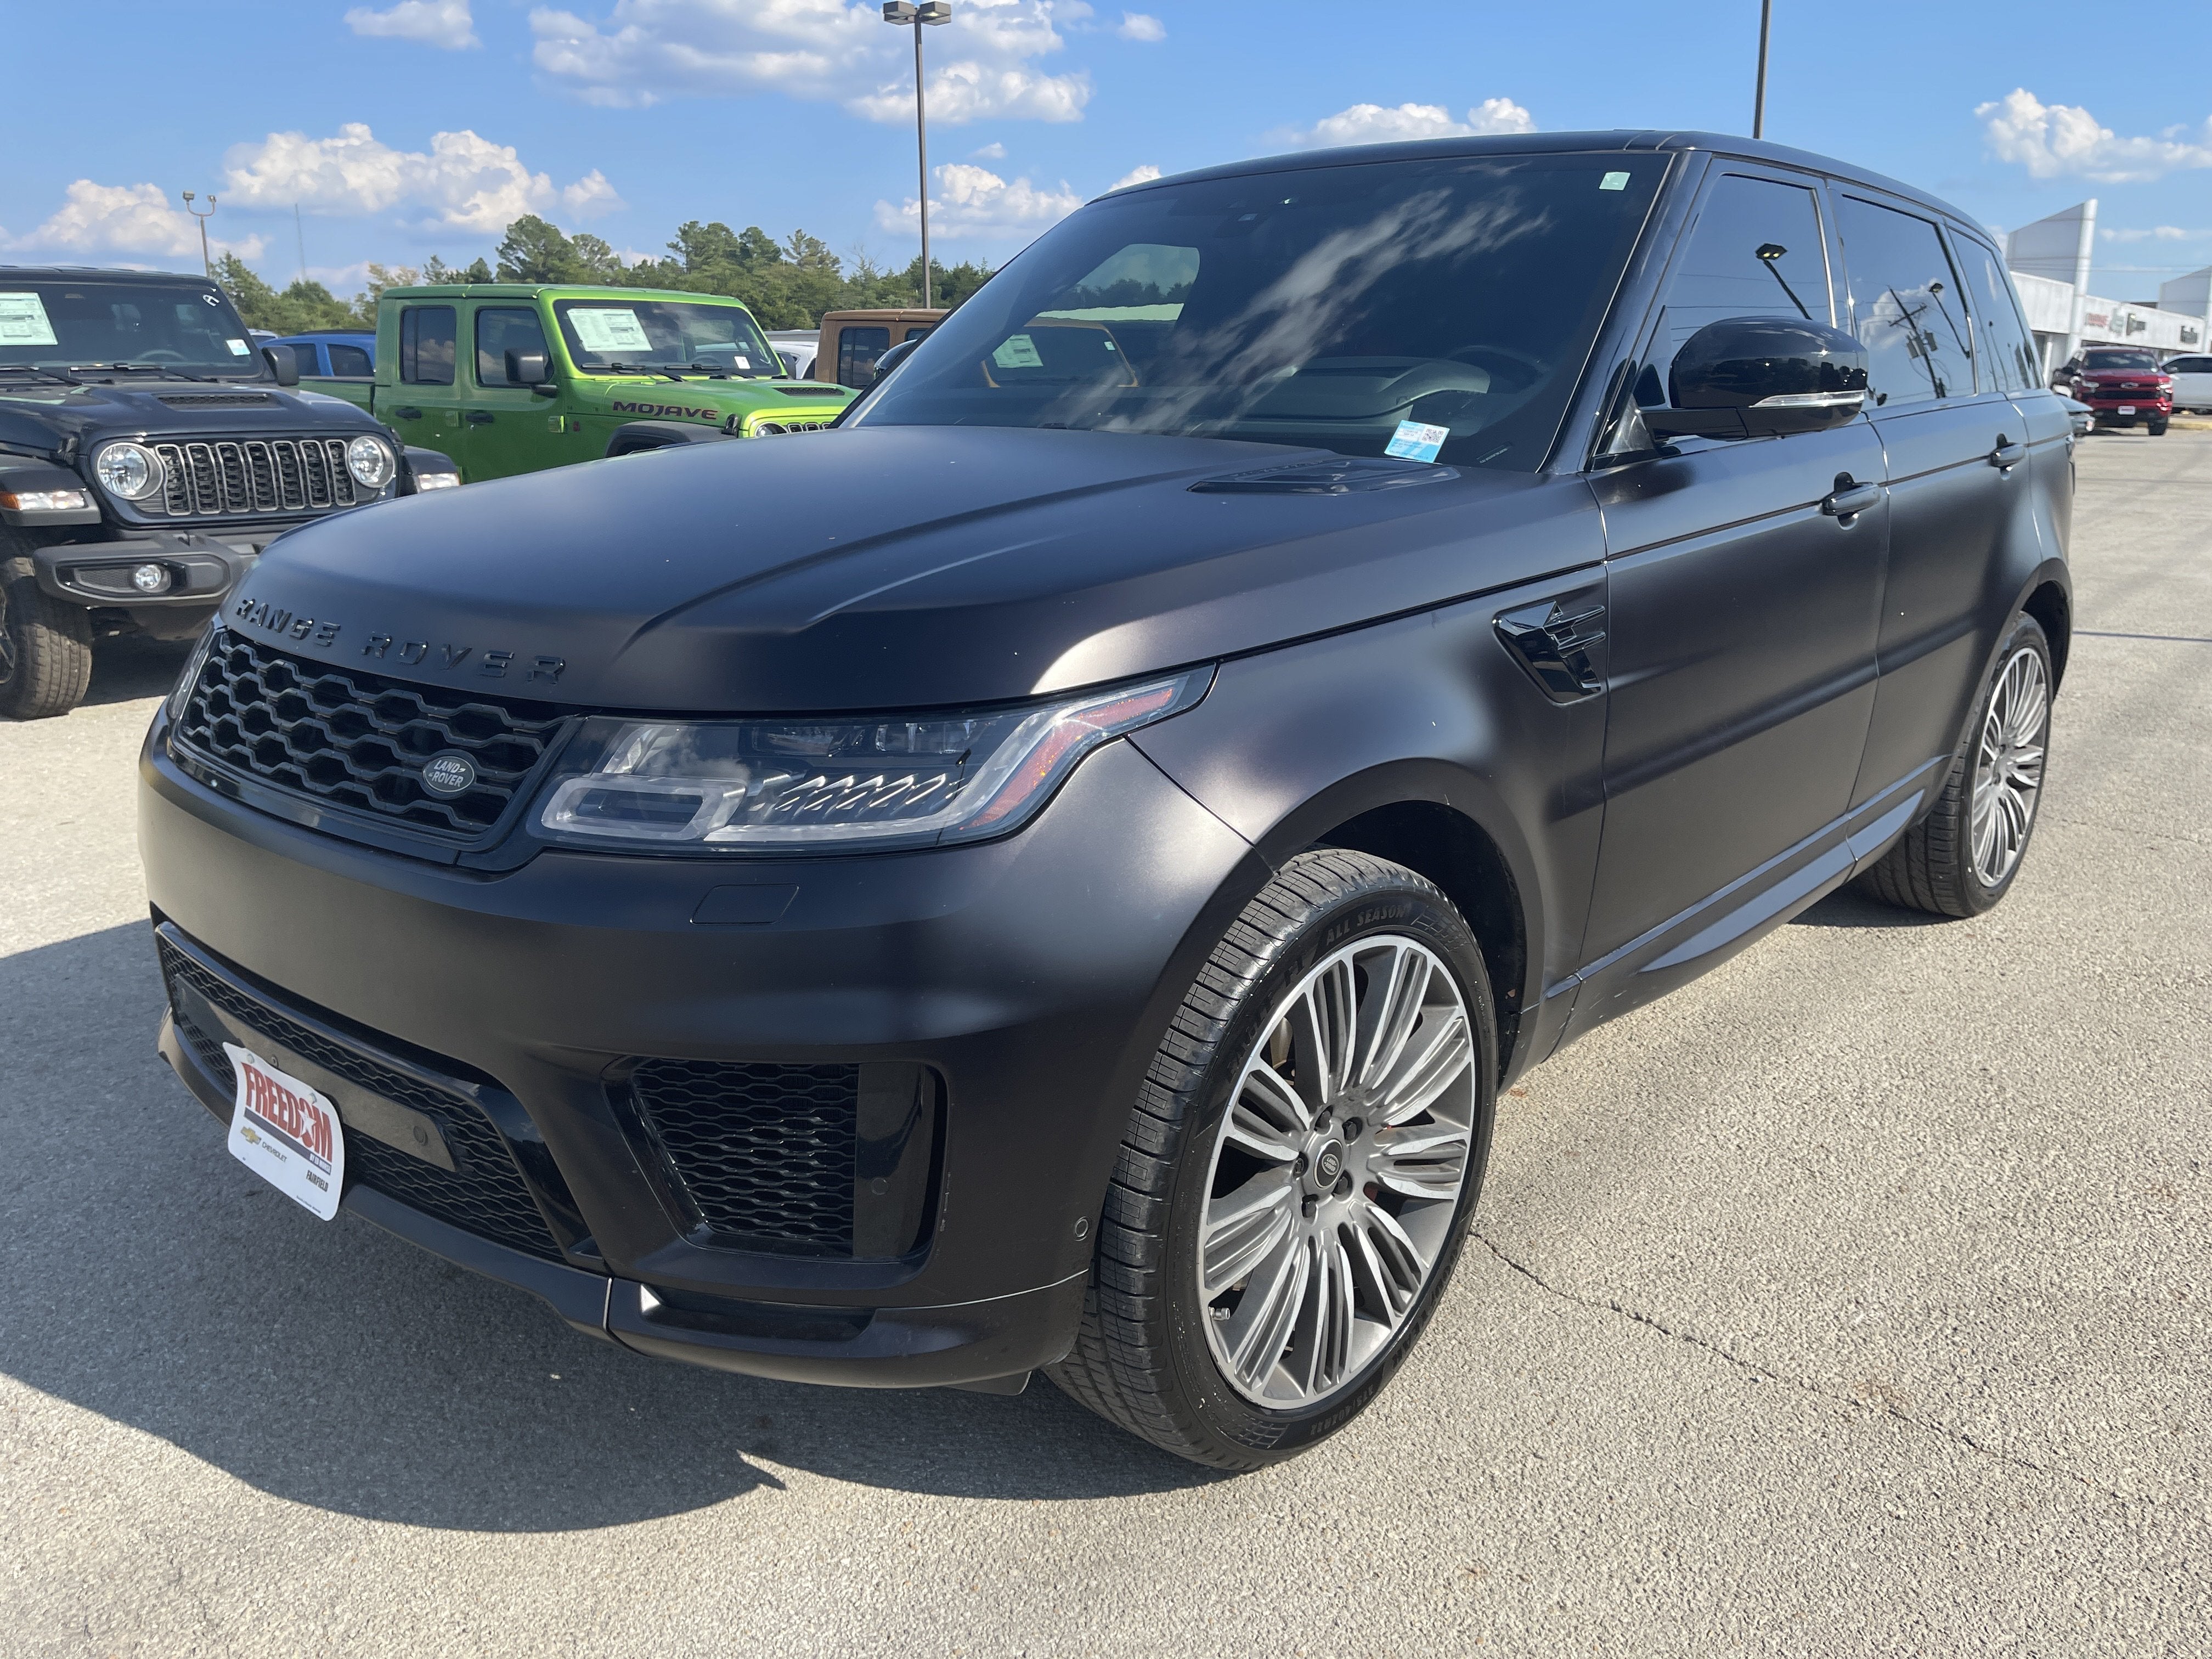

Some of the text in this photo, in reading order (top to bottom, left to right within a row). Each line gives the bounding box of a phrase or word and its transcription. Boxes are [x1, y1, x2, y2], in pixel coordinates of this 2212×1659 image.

[613, 401, 718, 420] MOJAVE
[236, 598, 566, 684] RANGE ROVER
[434, 760, 460, 773] LAND
[432, 771, 464, 787] ROVER
[1326, 919, 1350, 946] ALL
[1357, 904, 1406, 927] SEASON
[241, 1062, 332, 1163] FREEDOM
[262, 1141, 287, 1163] CHEVROLET
[306, 1170, 329, 1192] FAIRFIELD
